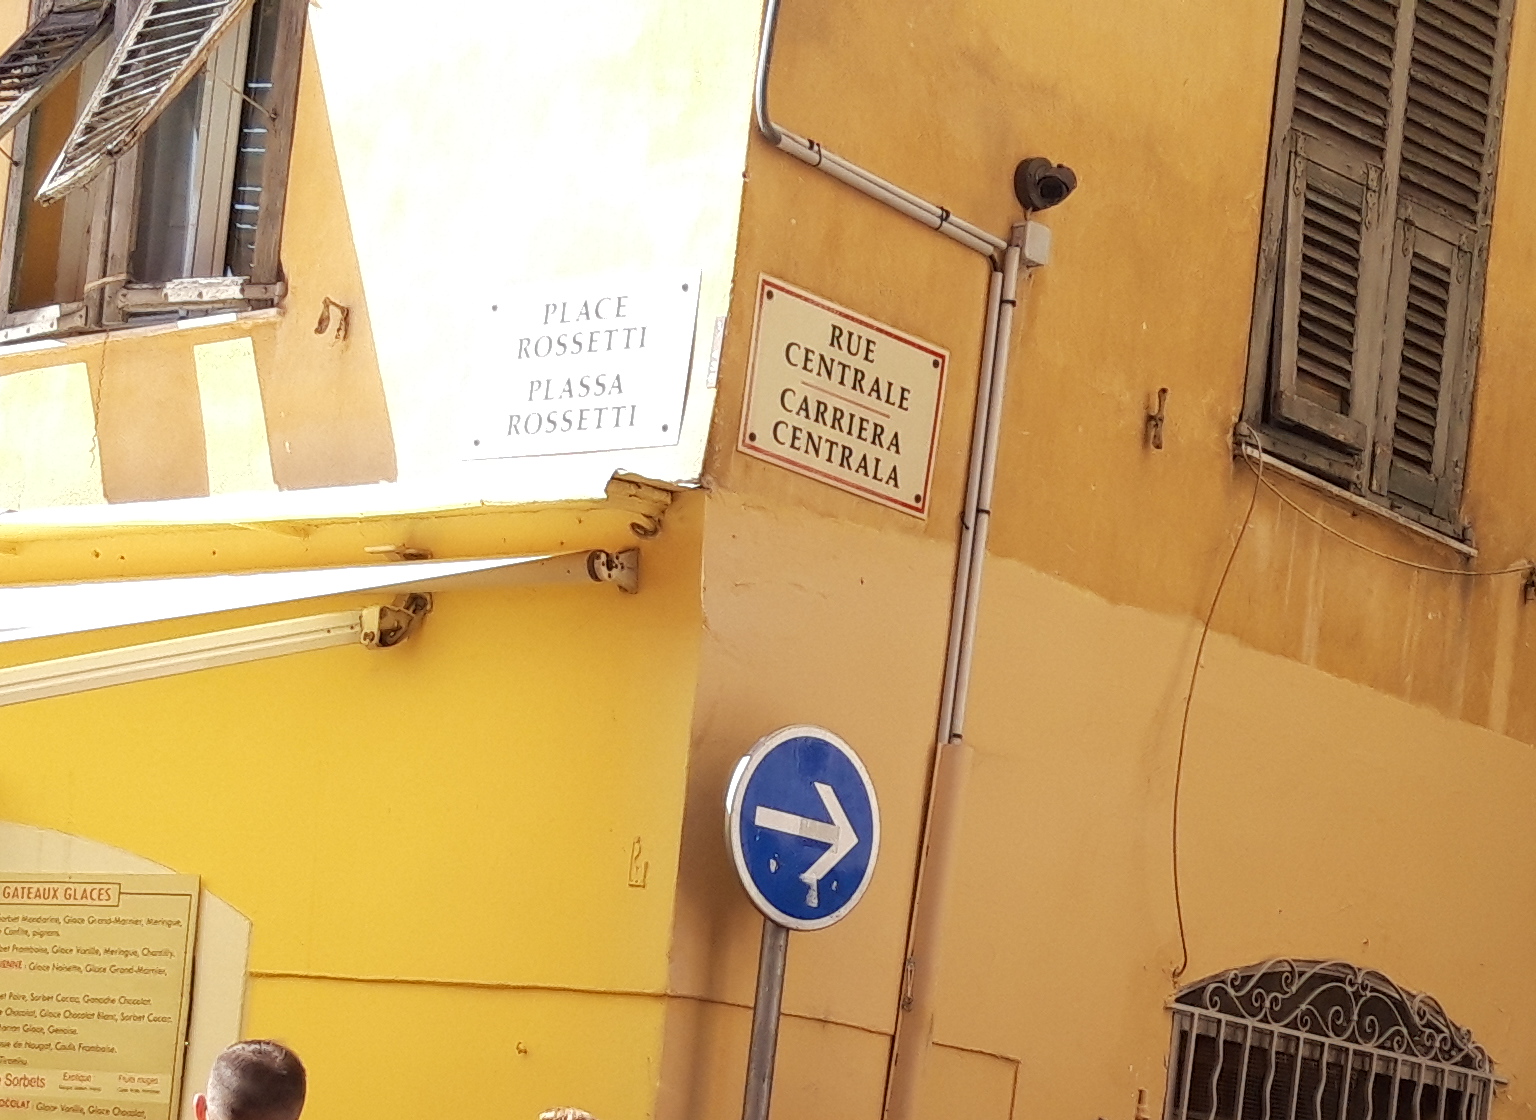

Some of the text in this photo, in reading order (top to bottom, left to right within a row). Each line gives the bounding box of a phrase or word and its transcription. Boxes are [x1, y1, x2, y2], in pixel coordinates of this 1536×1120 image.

[542, 295, 629, 325] PLACE
[516, 326, 648, 360] ROSSETTI
[829, 323, 877, 364] RUE
[527, 373, 625, 402] PLASSA
[784, 342, 912, 412] CENTRALE
[506, 404, 637, 436] ROSSETTI
[779, 387, 902, 455] CARRIERA
[771, 420, 901, 490] CENTRALA
[3, 885, 111, 902] GATEAUX GLACES
[4, 1072, 46, 1089] Sorbets
